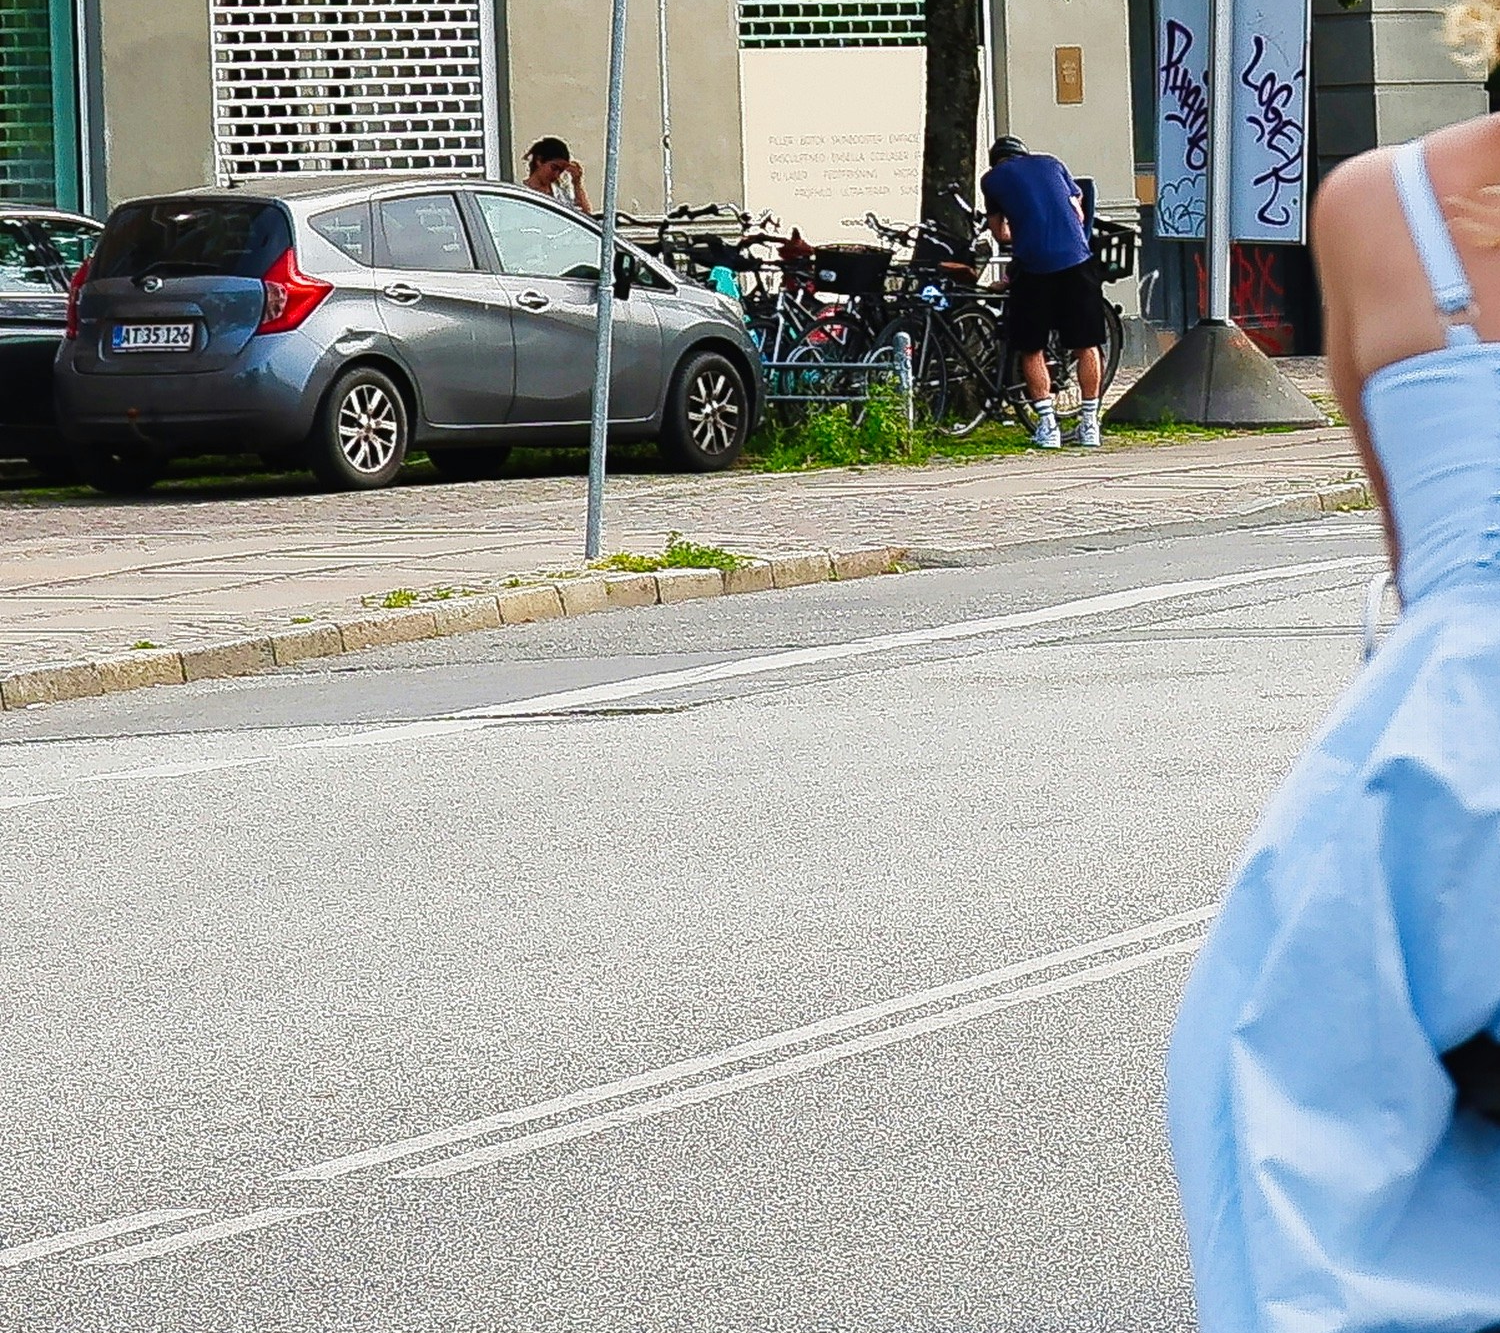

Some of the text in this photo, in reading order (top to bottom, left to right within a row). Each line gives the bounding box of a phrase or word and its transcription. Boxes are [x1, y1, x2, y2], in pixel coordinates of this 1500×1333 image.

[121, 326, 190, 345] AT 35 126
